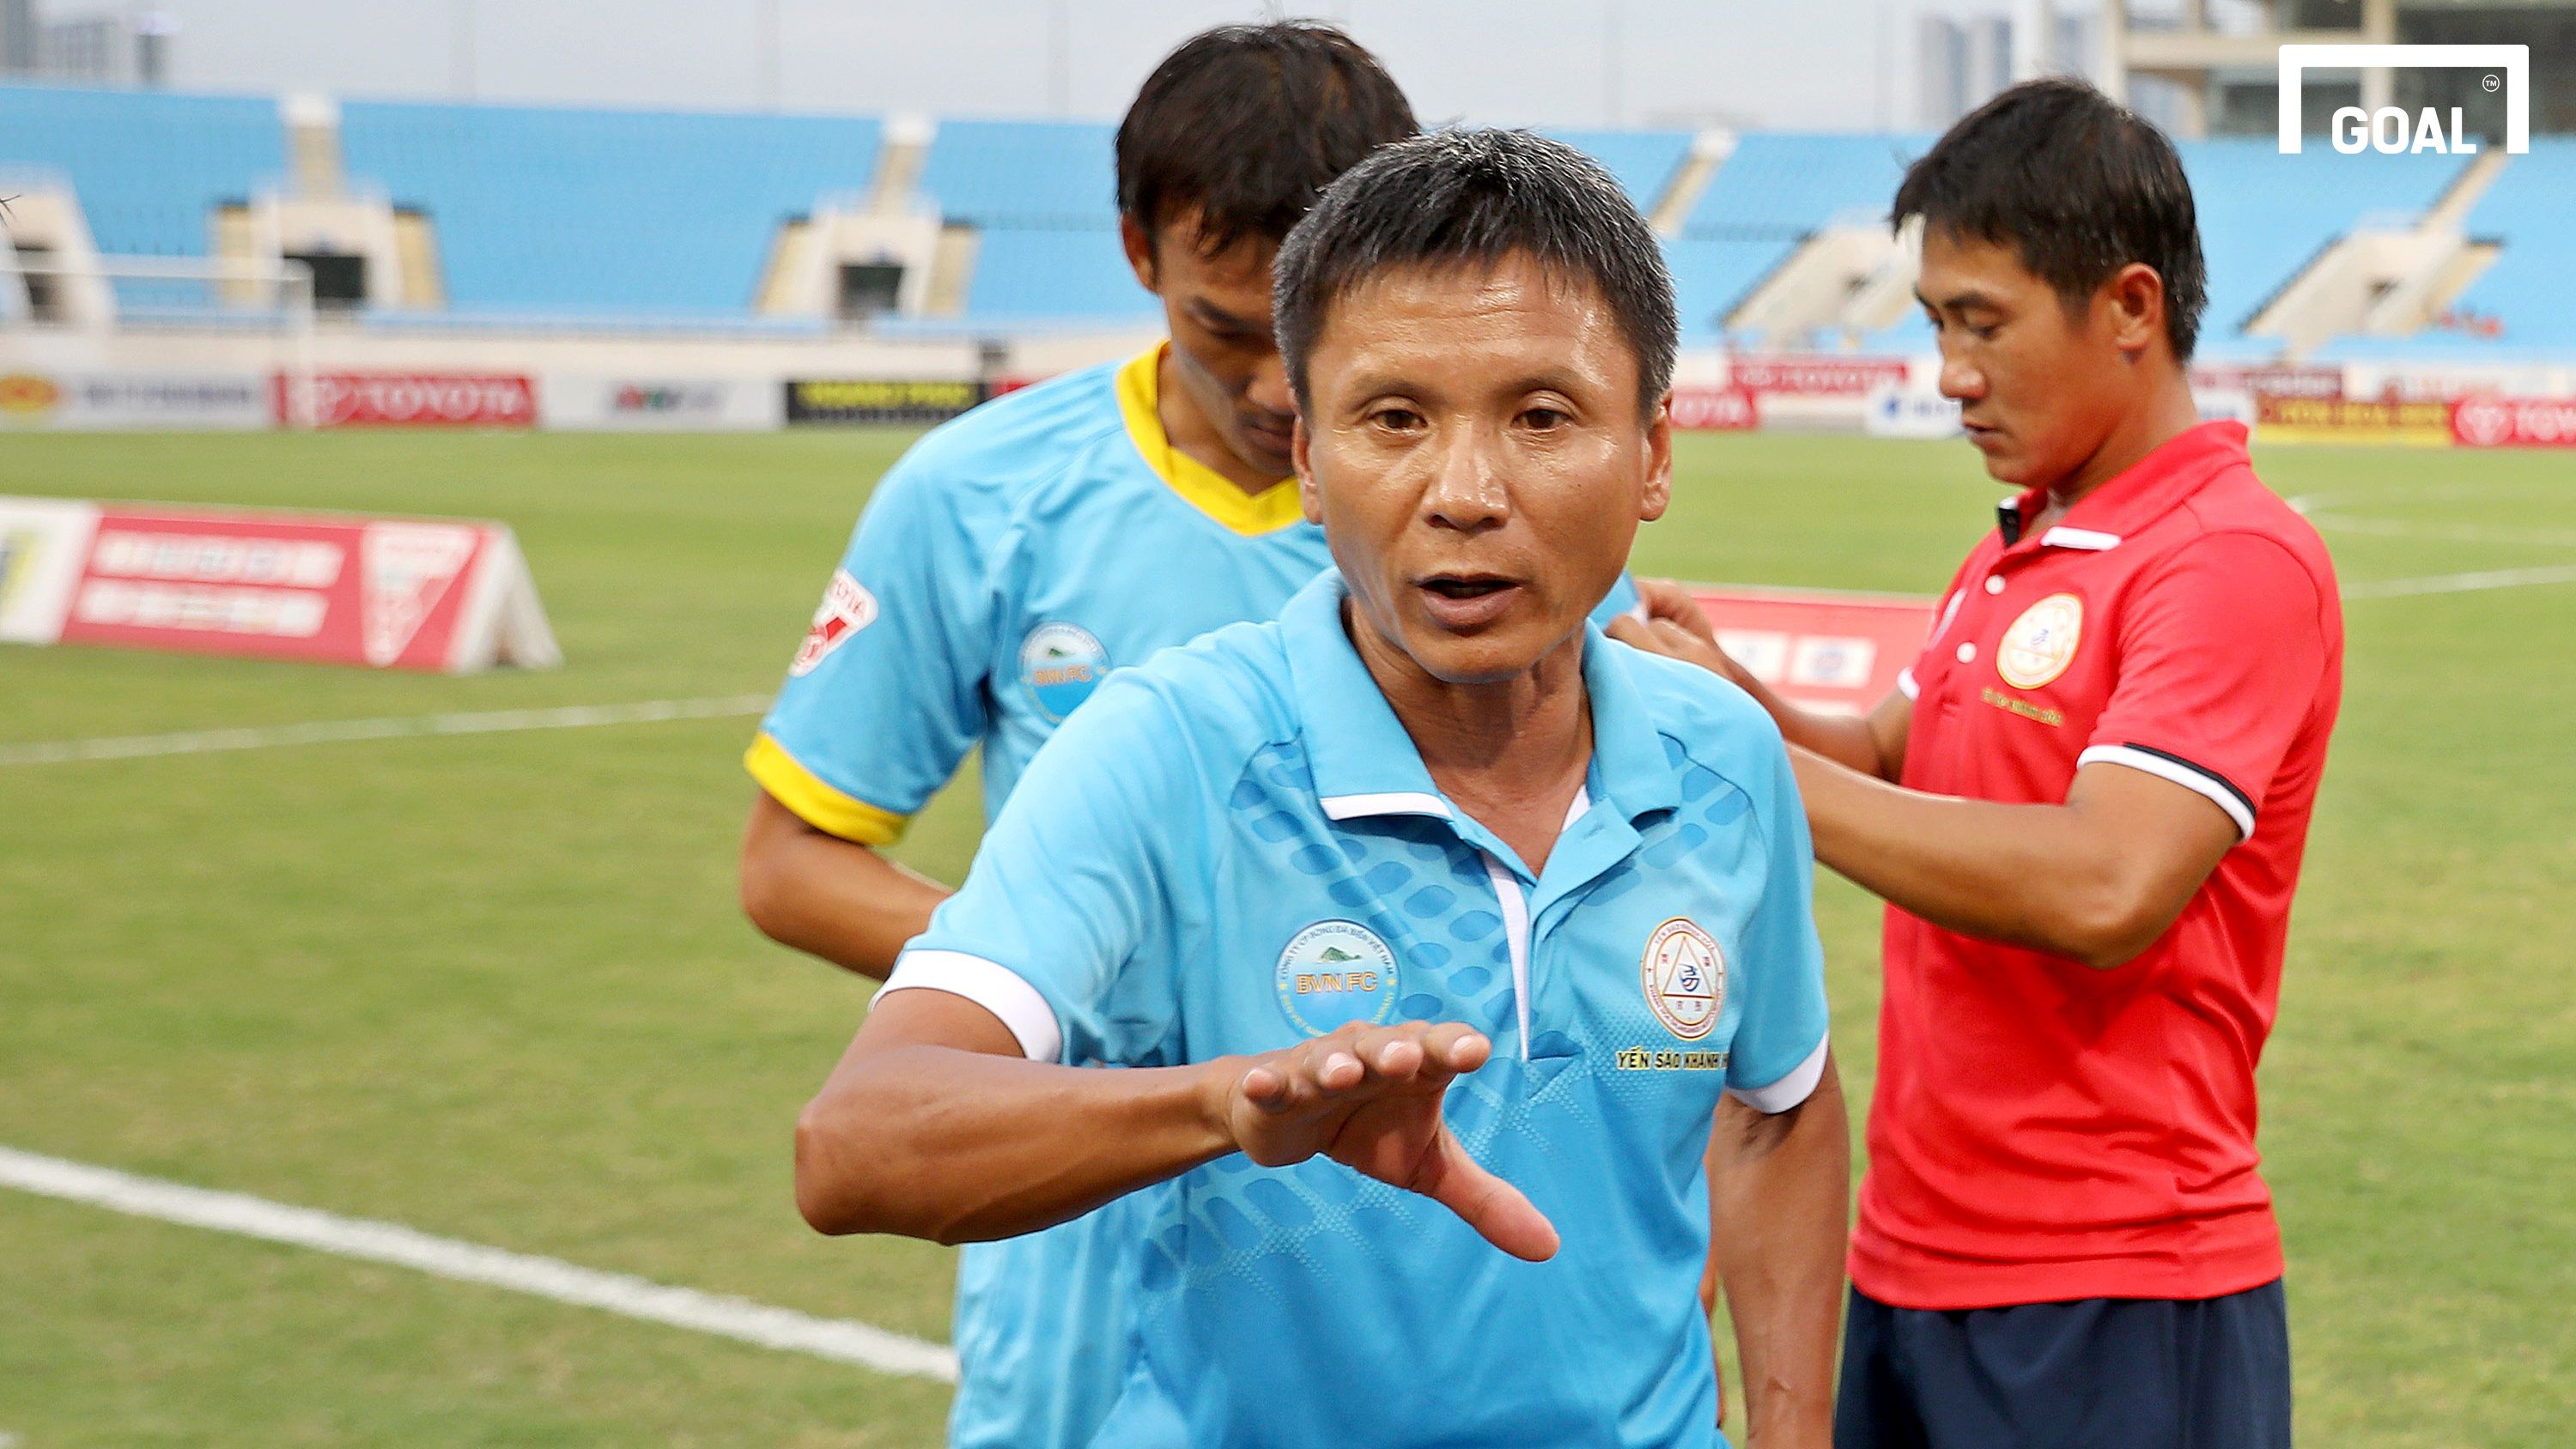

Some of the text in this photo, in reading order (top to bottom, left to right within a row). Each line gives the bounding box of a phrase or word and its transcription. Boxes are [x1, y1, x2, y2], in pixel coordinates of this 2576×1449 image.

[1296, 971, 1378, 995] BVN FC
[1617, 1046, 1652, 1070] YẾN
